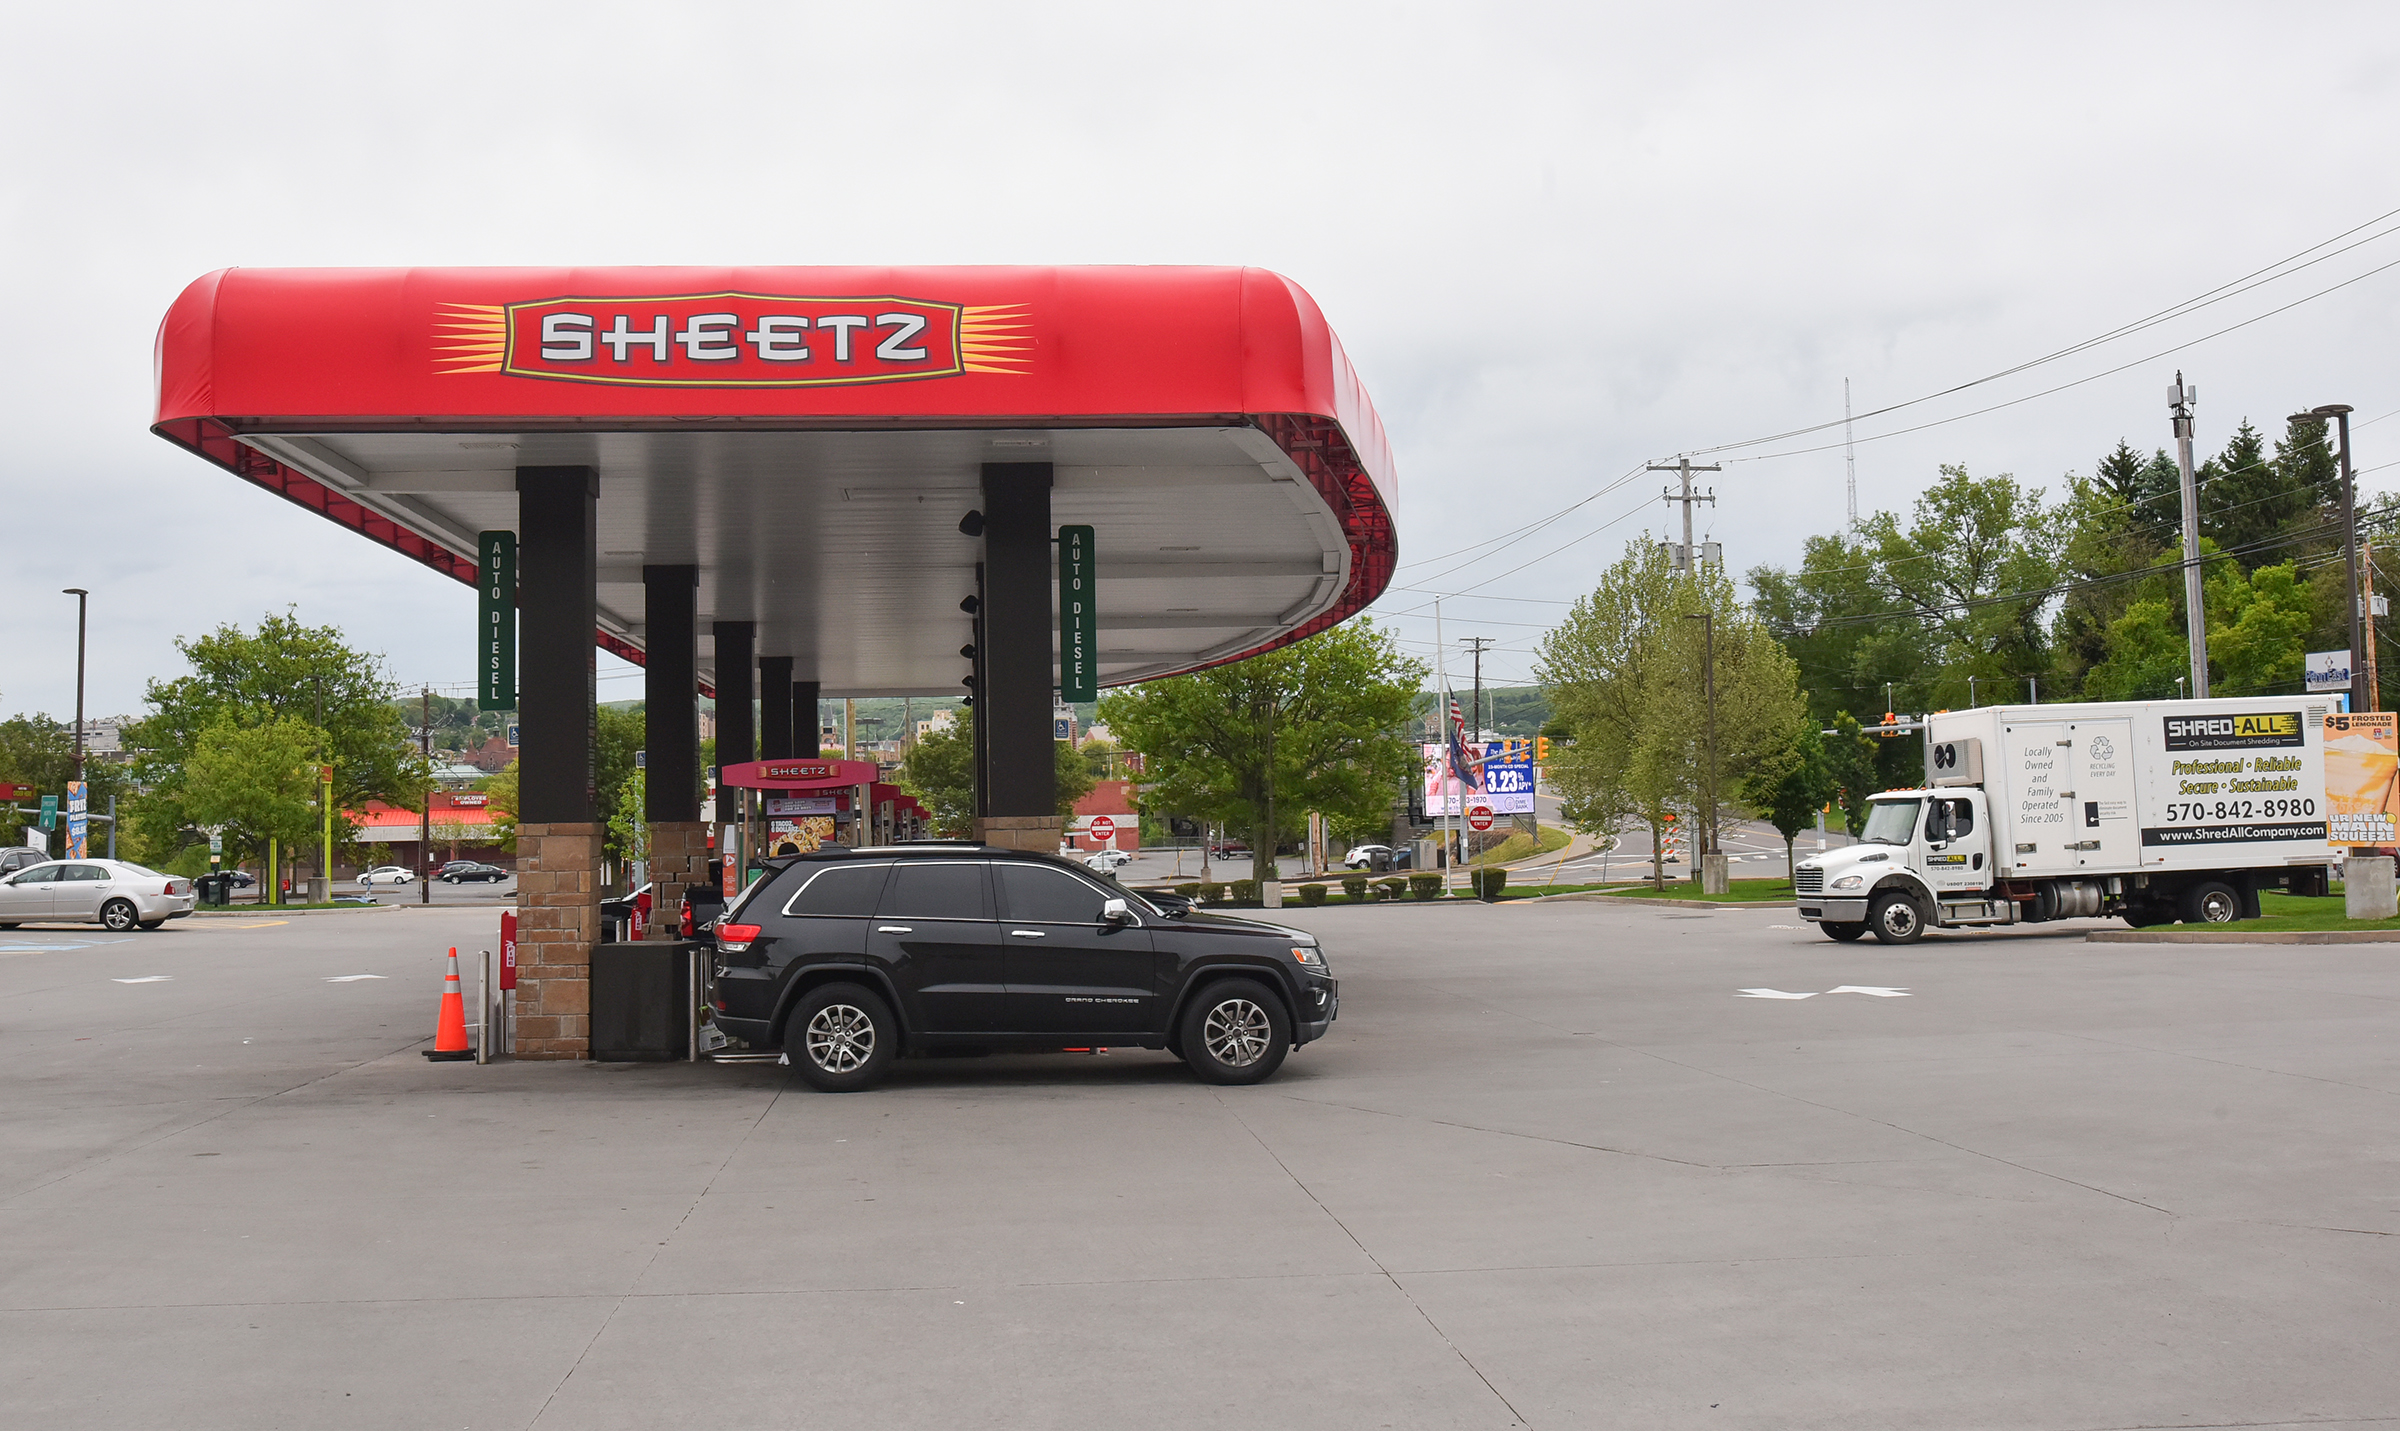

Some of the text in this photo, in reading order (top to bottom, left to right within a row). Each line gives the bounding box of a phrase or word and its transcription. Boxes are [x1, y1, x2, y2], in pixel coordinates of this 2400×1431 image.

[541, 312, 927, 362] SHEETZ
[1072, 533, 1083, 689] AUTO DIESEL
[491, 541, 501, 700] AUTO DIESEL
[2168, 717, 2282, 737] SHRED-ALL
[2325, 716, 2350, 731] $5
[2188, 739, 2199, 747] On
[2213, 738, 2246, 746] Document
[2247, 738, 2281, 746] Shredding
[2024, 747, 2052, 758] Locally
[2024, 760, 2053, 770] Owned
[2172, 756, 2302, 775] Professional Reliable
[770, 766, 826, 776] SHEETZ
[2032, 773, 2048, 783] and
[2179, 776, 2298, 795] Secure Sustainable
[2027, 787, 2054, 798] Family
[2022, 800, 2059, 812] Operated
[2166, 798, 2315, 822] 570-842-8980
[2021, 813, 2064, 824] Since 2005
[2329, 813, 2387, 822] UR NEW
[2331, 822, 2394, 832] MAIN
[2159, 826, 2324, 842] www.ShredAllCompany.com
[2330, 831, 2396, 841] SQUEEZE
